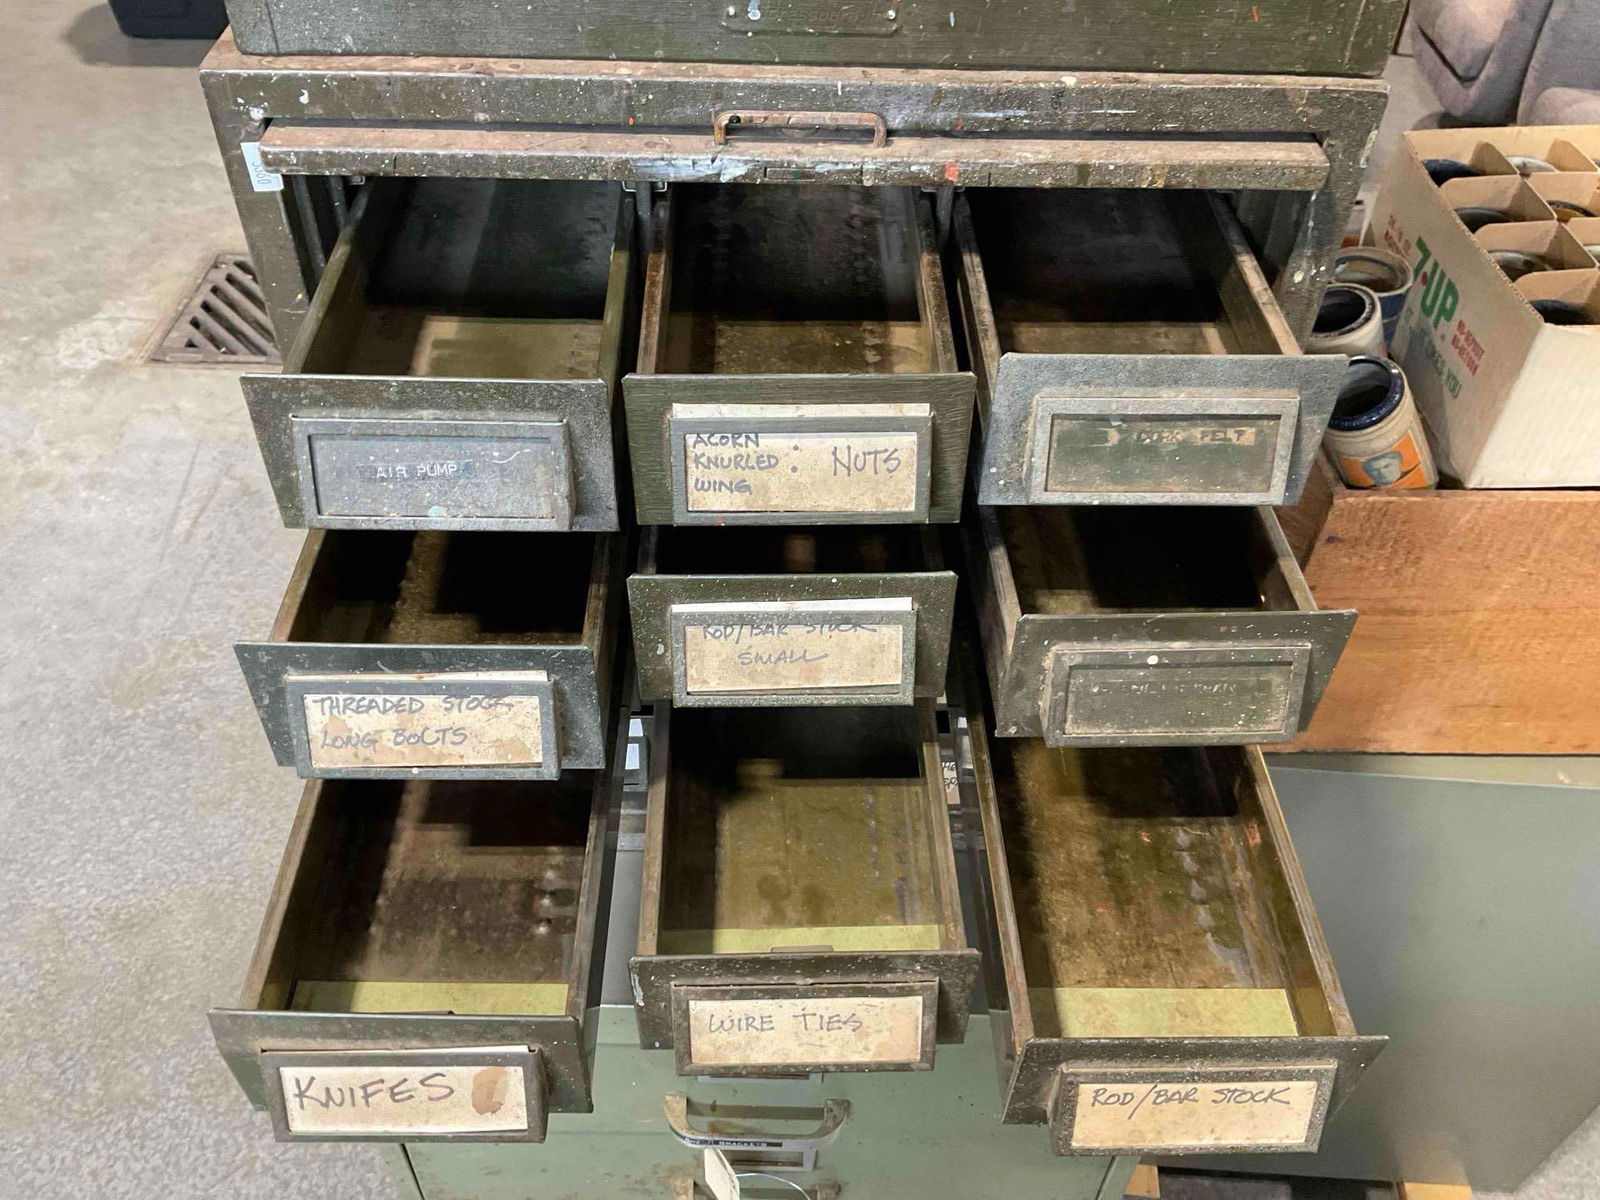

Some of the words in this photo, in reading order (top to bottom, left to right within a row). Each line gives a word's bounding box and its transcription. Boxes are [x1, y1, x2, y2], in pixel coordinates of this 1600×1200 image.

[692, 433, 760, 449] ACORN
[376, 466, 407, 479] AIR
[416, 463, 458, 478] PUMP
[693, 453, 779, 471] KNURLED
[831, 445, 902, 477] NUTS
[693, 478, 753, 495] WING
[737, 650, 829, 666] SMALL
[313, 696, 425, 716] THREADED
[444, 695, 514, 713] STOCK
[321, 731, 378, 752] LONG
[392, 727, 468, 746] BOLTS
[708, 1013, 775, 1033] WIRE
[793, 1012, 863, 1033] TIES
[293, 1072, 455, 1111] KNIFES
[1091, 1082, 1199, 1120] ROD/BAR
[1211, 1086, 1291, 1105] STOCK
